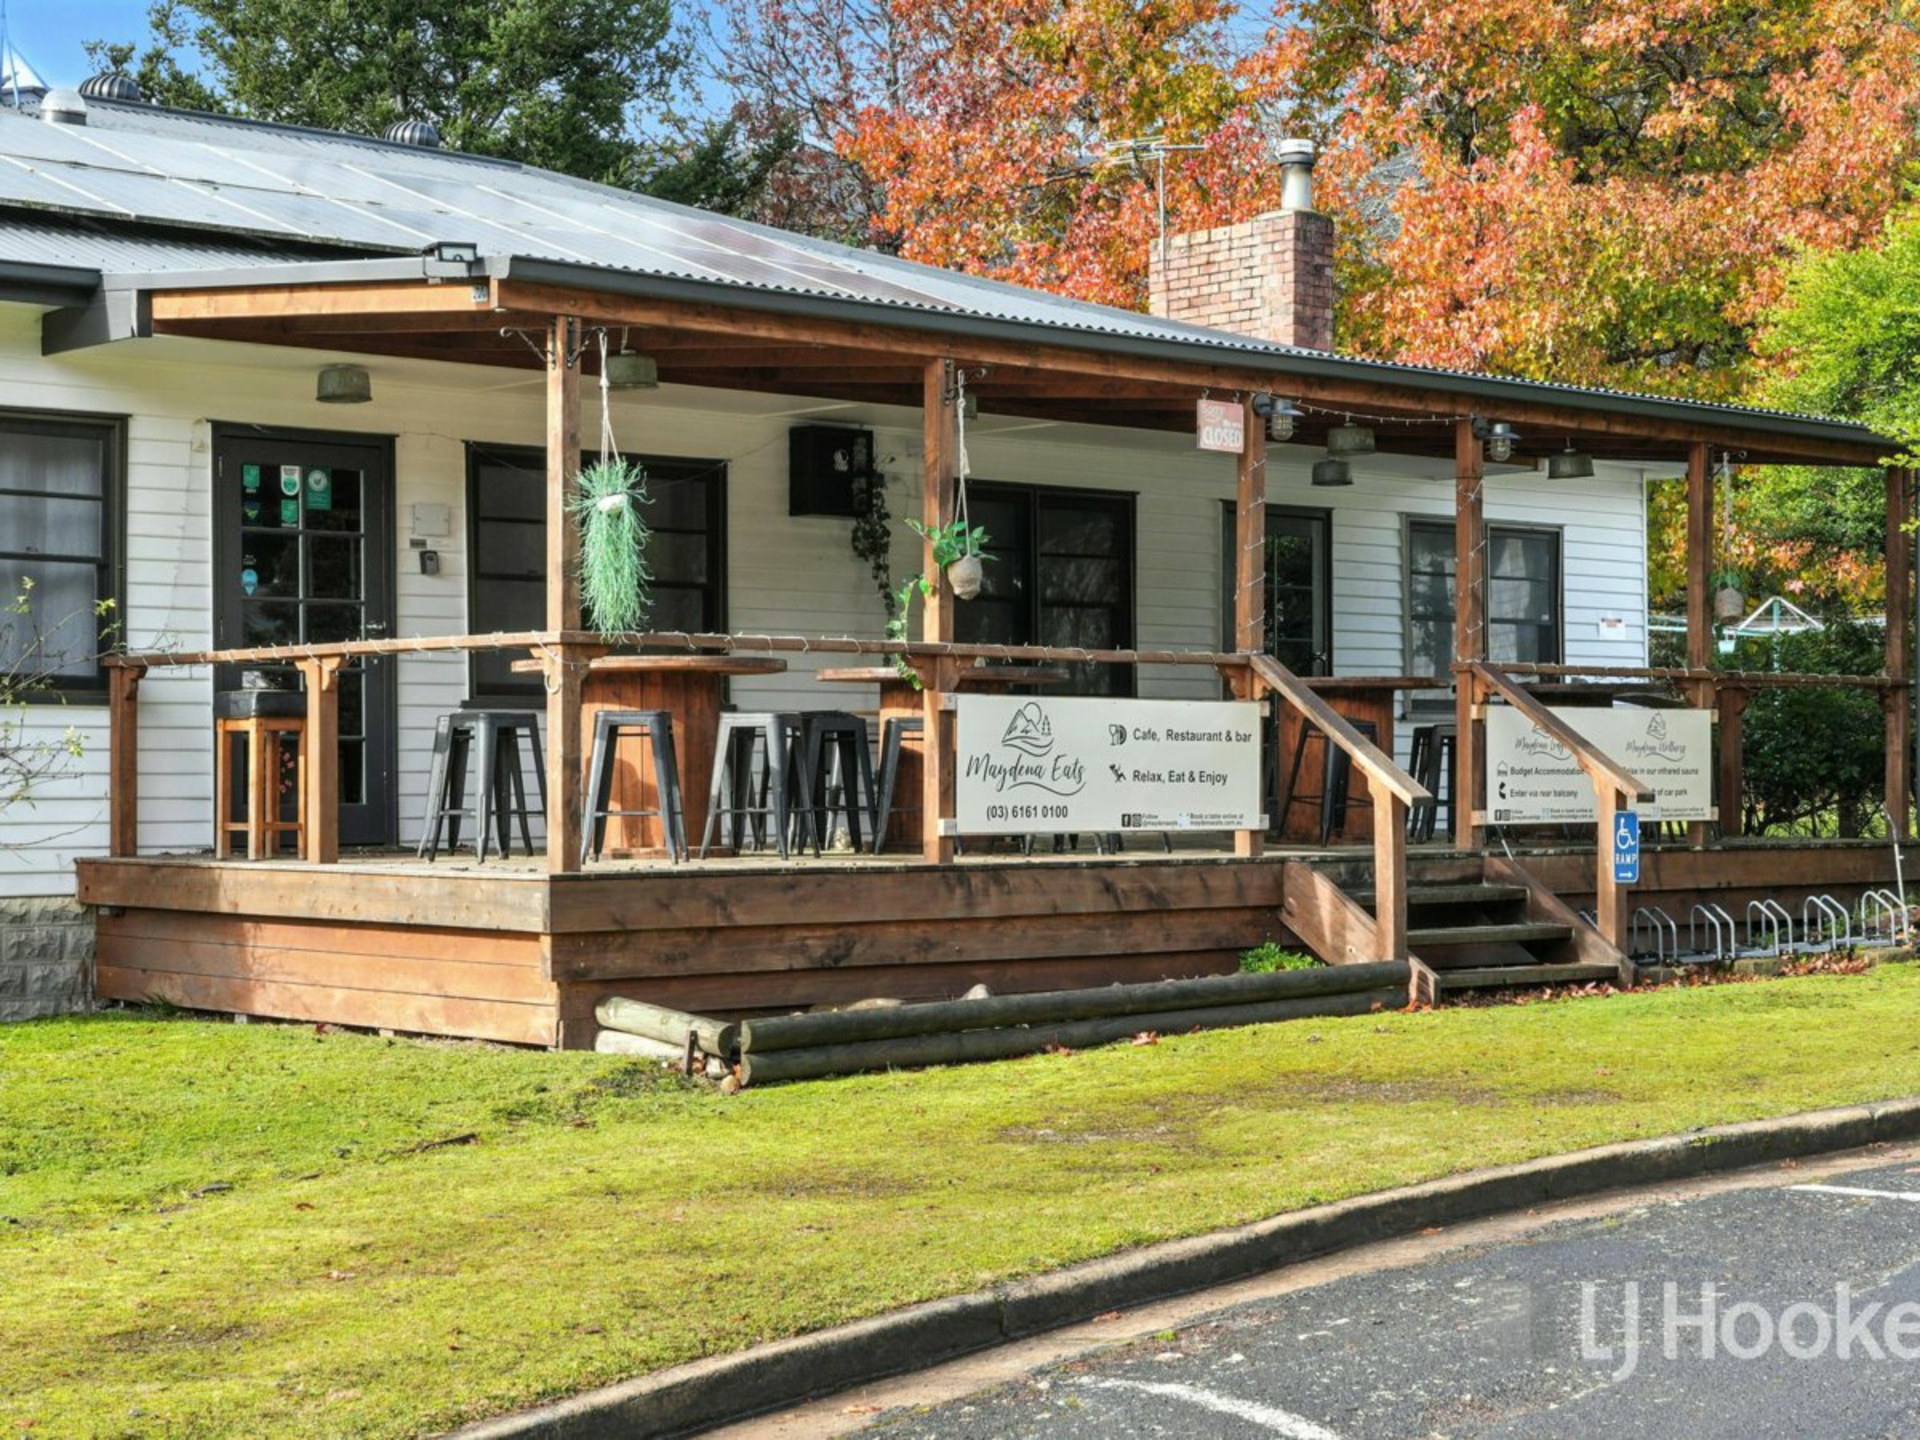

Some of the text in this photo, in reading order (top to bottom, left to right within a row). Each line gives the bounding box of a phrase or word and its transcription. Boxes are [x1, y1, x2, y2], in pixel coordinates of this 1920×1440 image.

[1201, 426, 1241, 448] CLOSED
[1133, 728, 1252, 743] Cafe, Restaurant & bar
[966, 752, 1087, 793] Maydena Eats
[1132, 769, 1228, 786] Relax, Eat & Enjoy
[1510, 766, 1585, 777] Budget Accommodation
[1510, 788, 1578, 799] Enter via rear balcony
[1657, 788, 1663, 796] of
[1675, 788, 1688, 797] park
[986, 805, 1068, 821] (03) 6161 0100
[1615, 853, 1637, 865] RAMP
